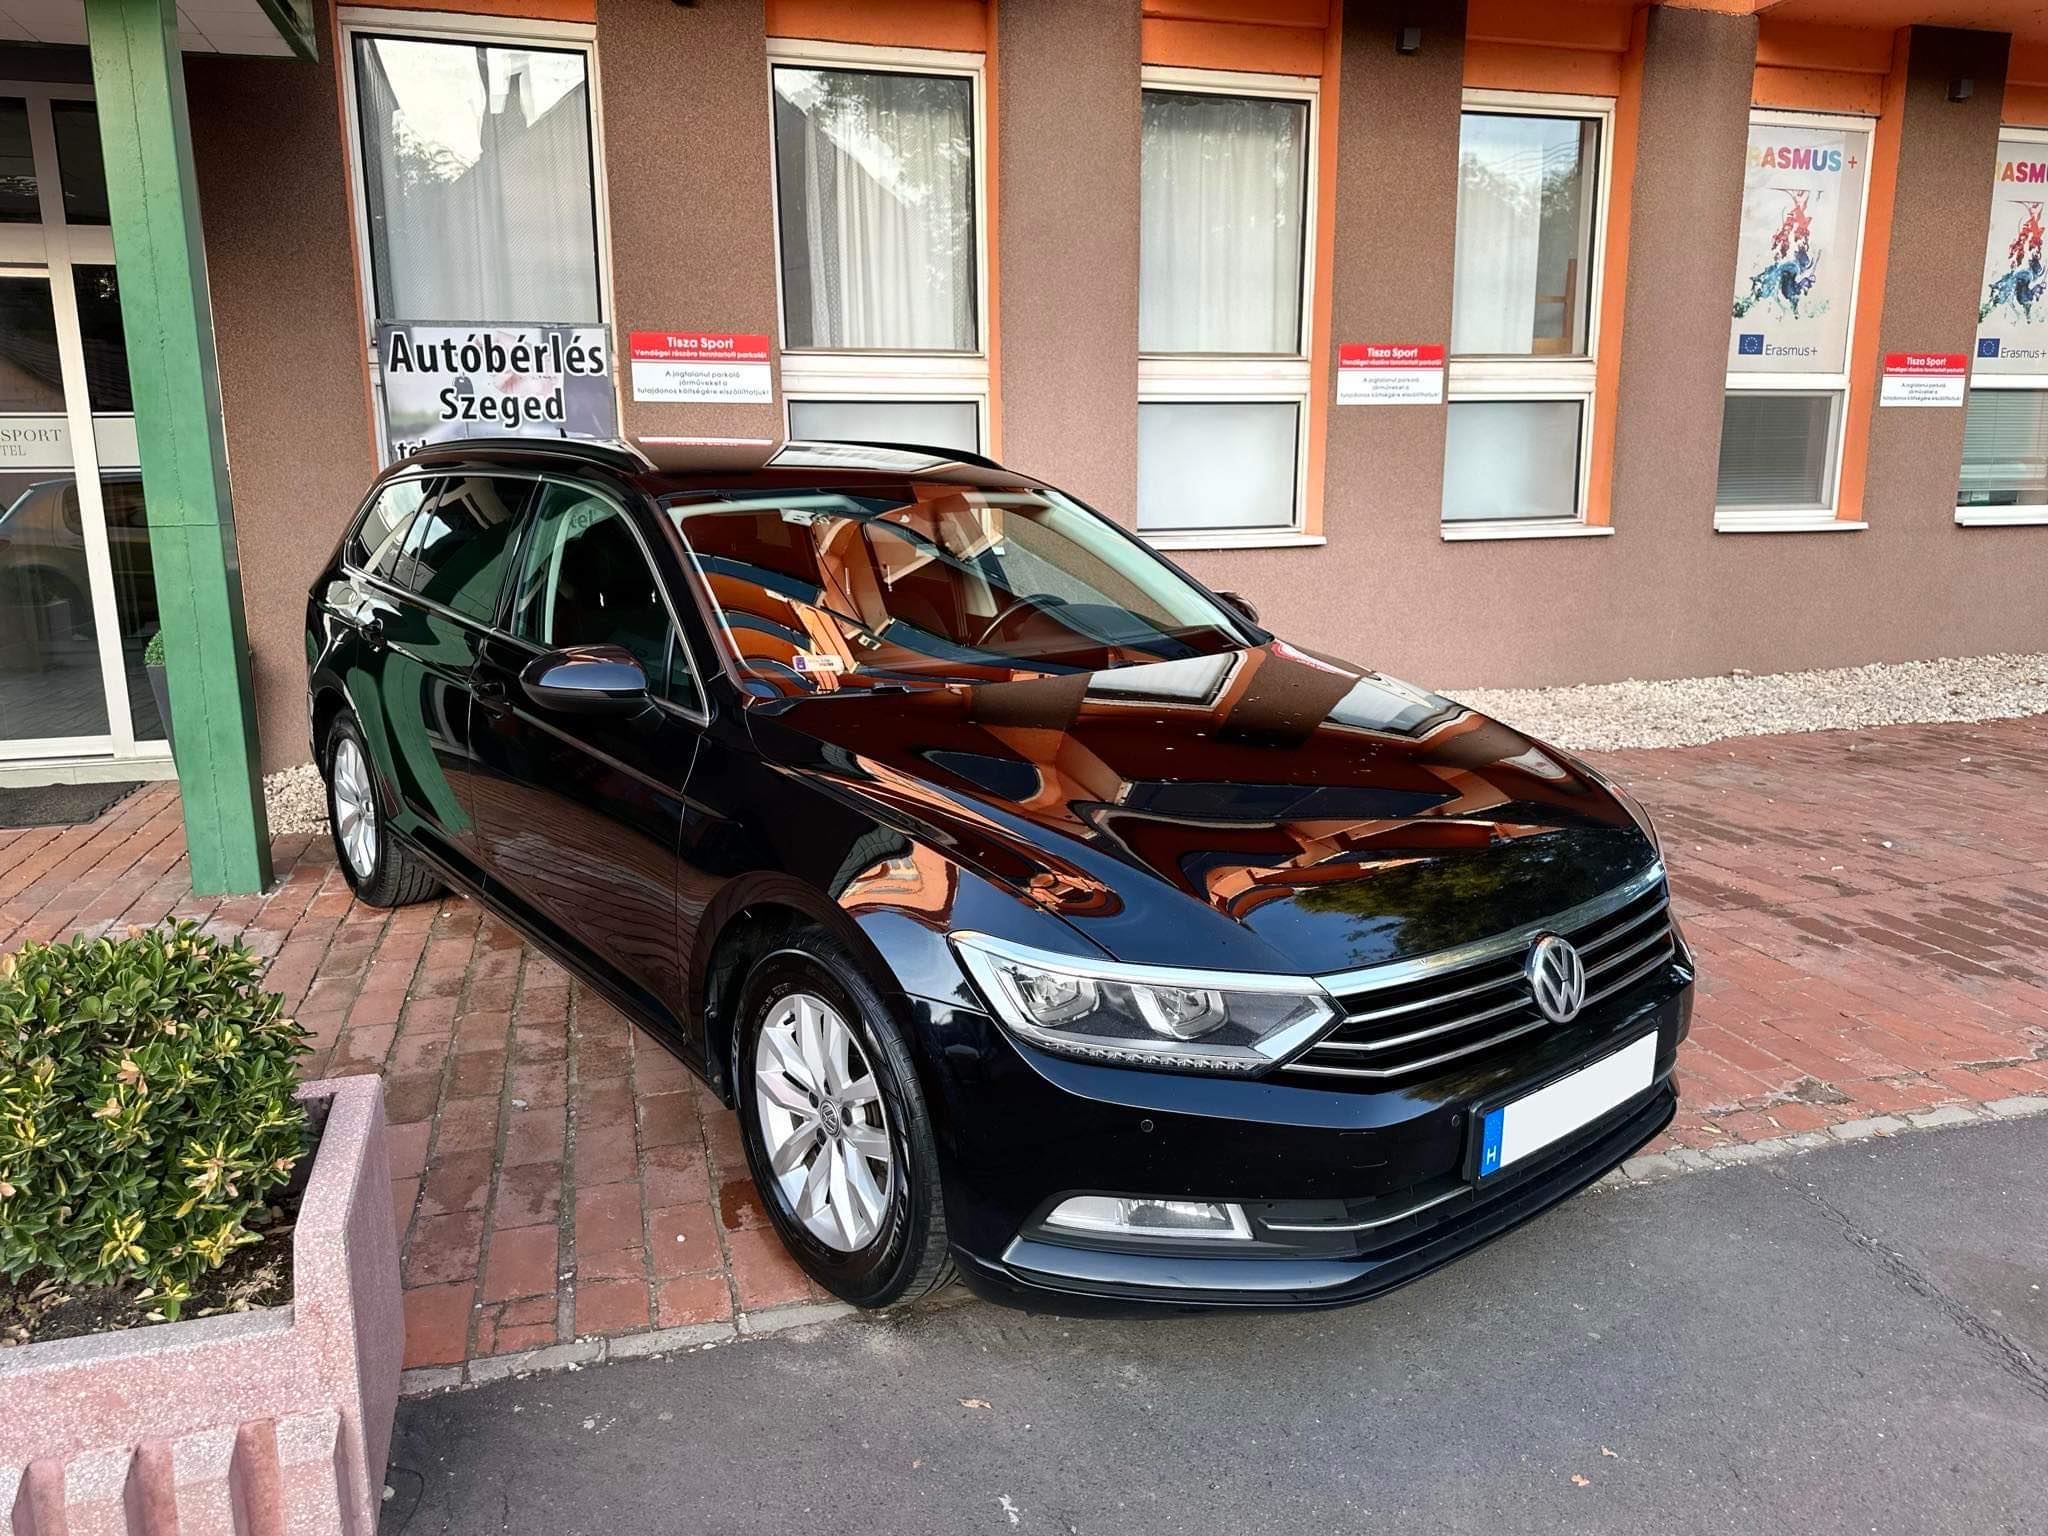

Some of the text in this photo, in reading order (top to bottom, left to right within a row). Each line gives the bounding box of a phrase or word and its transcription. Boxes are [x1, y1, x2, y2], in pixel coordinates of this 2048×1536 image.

[666, 336, 735, 350] Tisza Sport
[389, 333, 605, 373] Autóbérlés
[1367, 347, 1418, 360] Tisza Sport
[1765, 344, 1818, 356] Erasmus+
[2000, 347, 2047, 359] Erasmus+
[1926, 357, 1947, 368] Sport
[672, 370, 711, 379] jogtalanul
[711, 371, 741, 379] parkoló
[637, 387, 678, 395] tulajdonos
[440, 388, 565, 428] Szeged
[1, 429, 62, 441] SPORT
[1486, 1145, 1498, 1166] H
